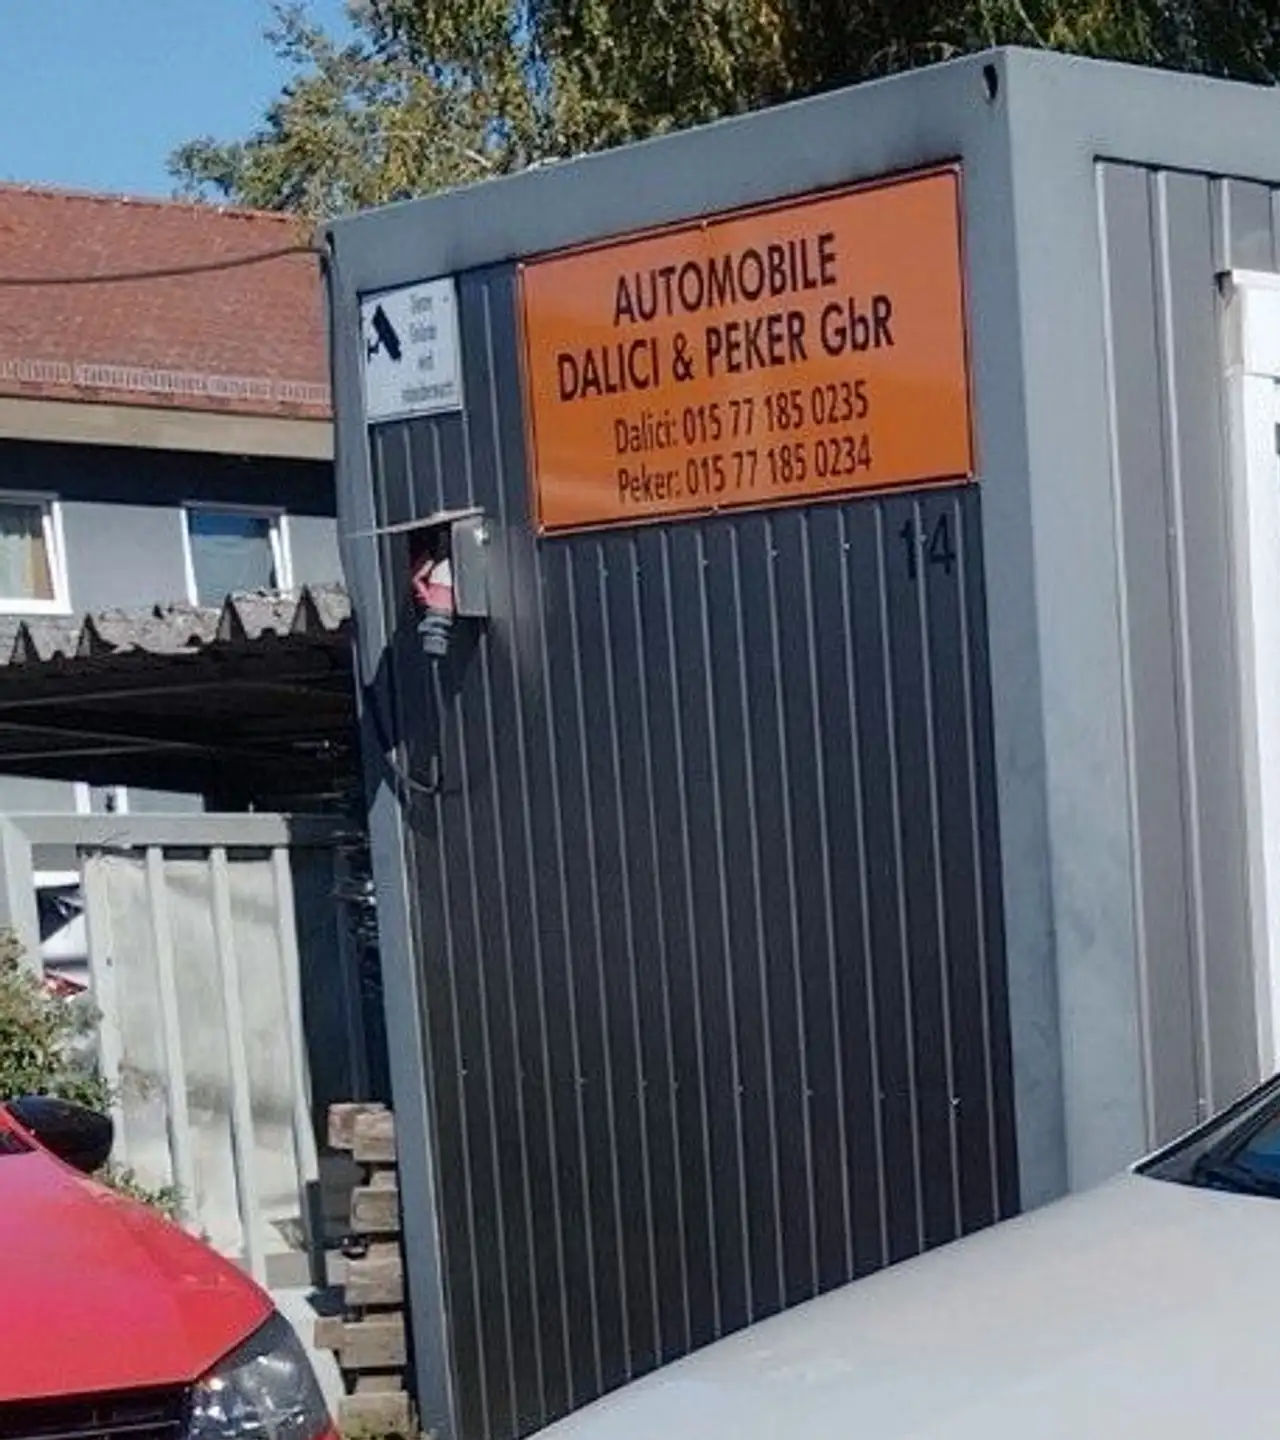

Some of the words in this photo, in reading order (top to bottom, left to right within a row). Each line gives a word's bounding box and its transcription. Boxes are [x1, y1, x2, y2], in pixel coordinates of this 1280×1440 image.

[613, 232, 837, 326] AUTOMOBILE
[557, 337, 661, 402] DALICI
[672, 332, 695, 383] &
[705, 310, 808, 379] PEKER
[820, 294, 895, 358] GbR
[614, 408, 678, 454] Dalici:
[683, 403, 722, 446] 015
[729, 397, 755, 438] 77
[764, 390, 803, 432] 185
[811, 379, 869, 425] 0235
[617, 465, 682, 503] Peker:
[686, 455, 727, 496] 015
[731, 448, 758, 489] 77
[767, 442, 808, 485] 185
[815, 433, 872, 478] 0234
[900, 512, 956, 579] 14
